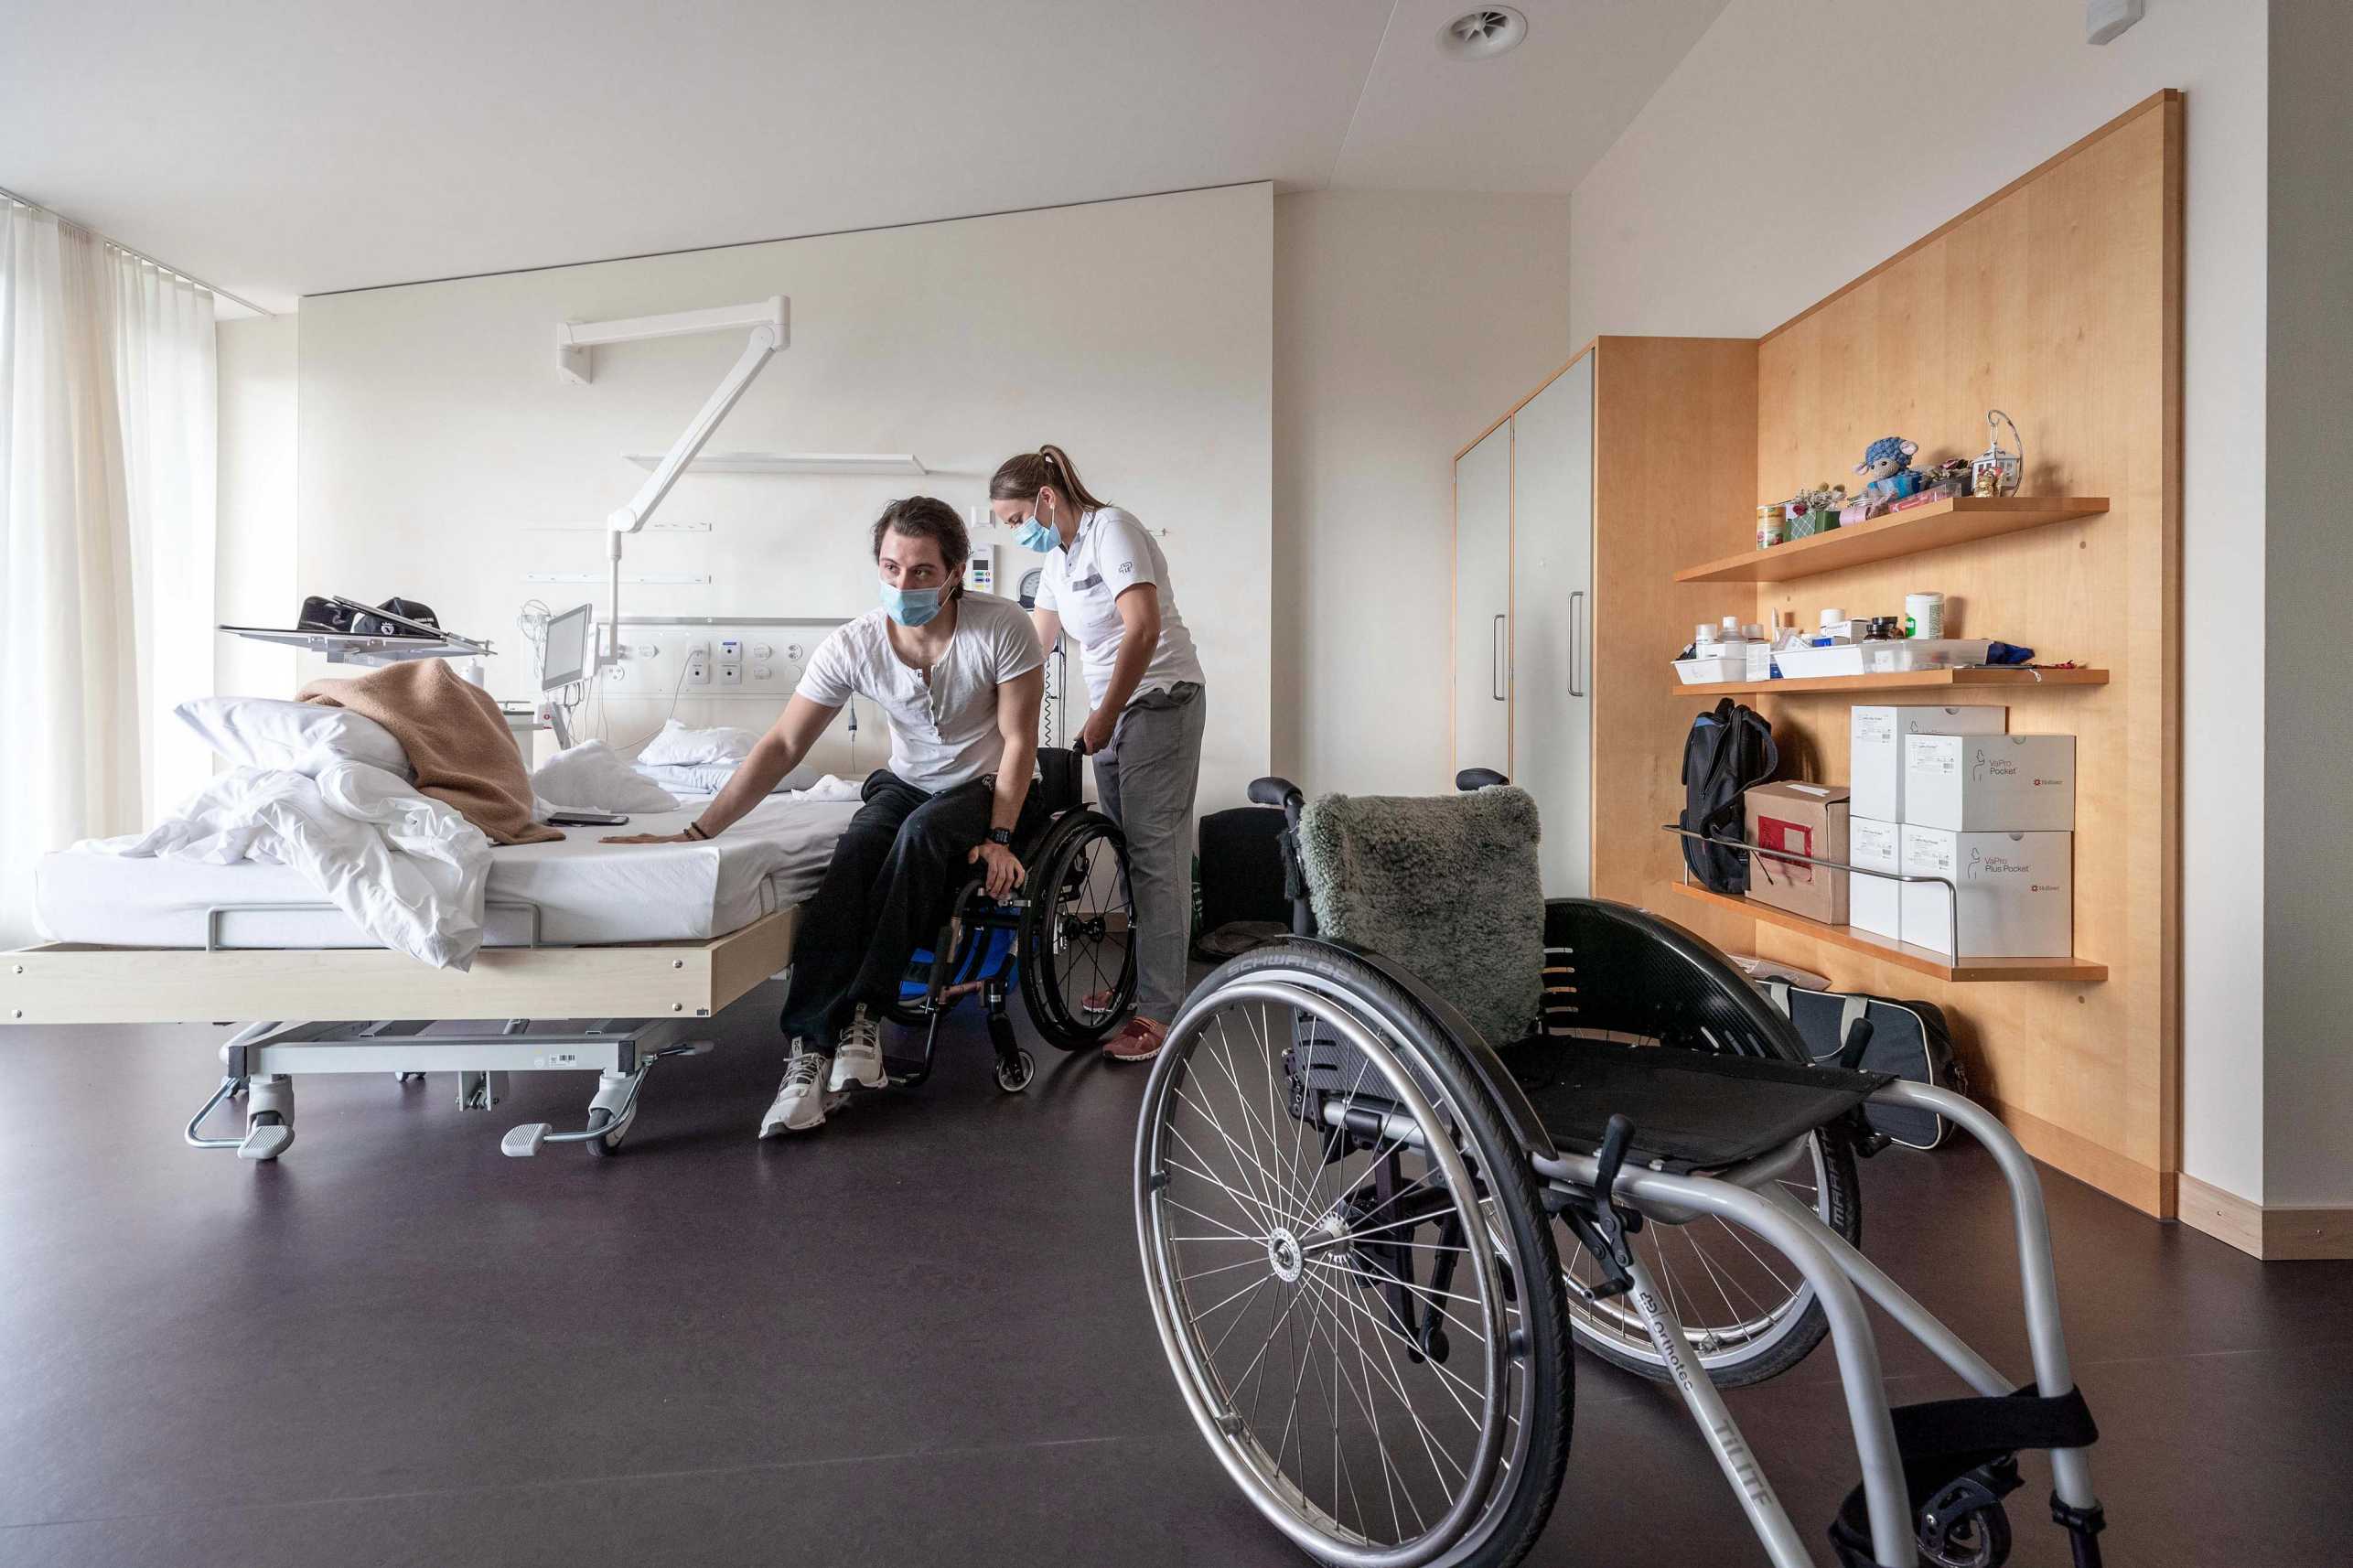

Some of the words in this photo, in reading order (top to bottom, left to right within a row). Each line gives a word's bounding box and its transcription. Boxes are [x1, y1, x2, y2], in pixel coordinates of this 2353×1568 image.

[1990, 767, 2016, 775] Pocket
[1227, 954, 1350, 983] SCHWALBE
[1818, 1127, 1844, 1227] MARATH
